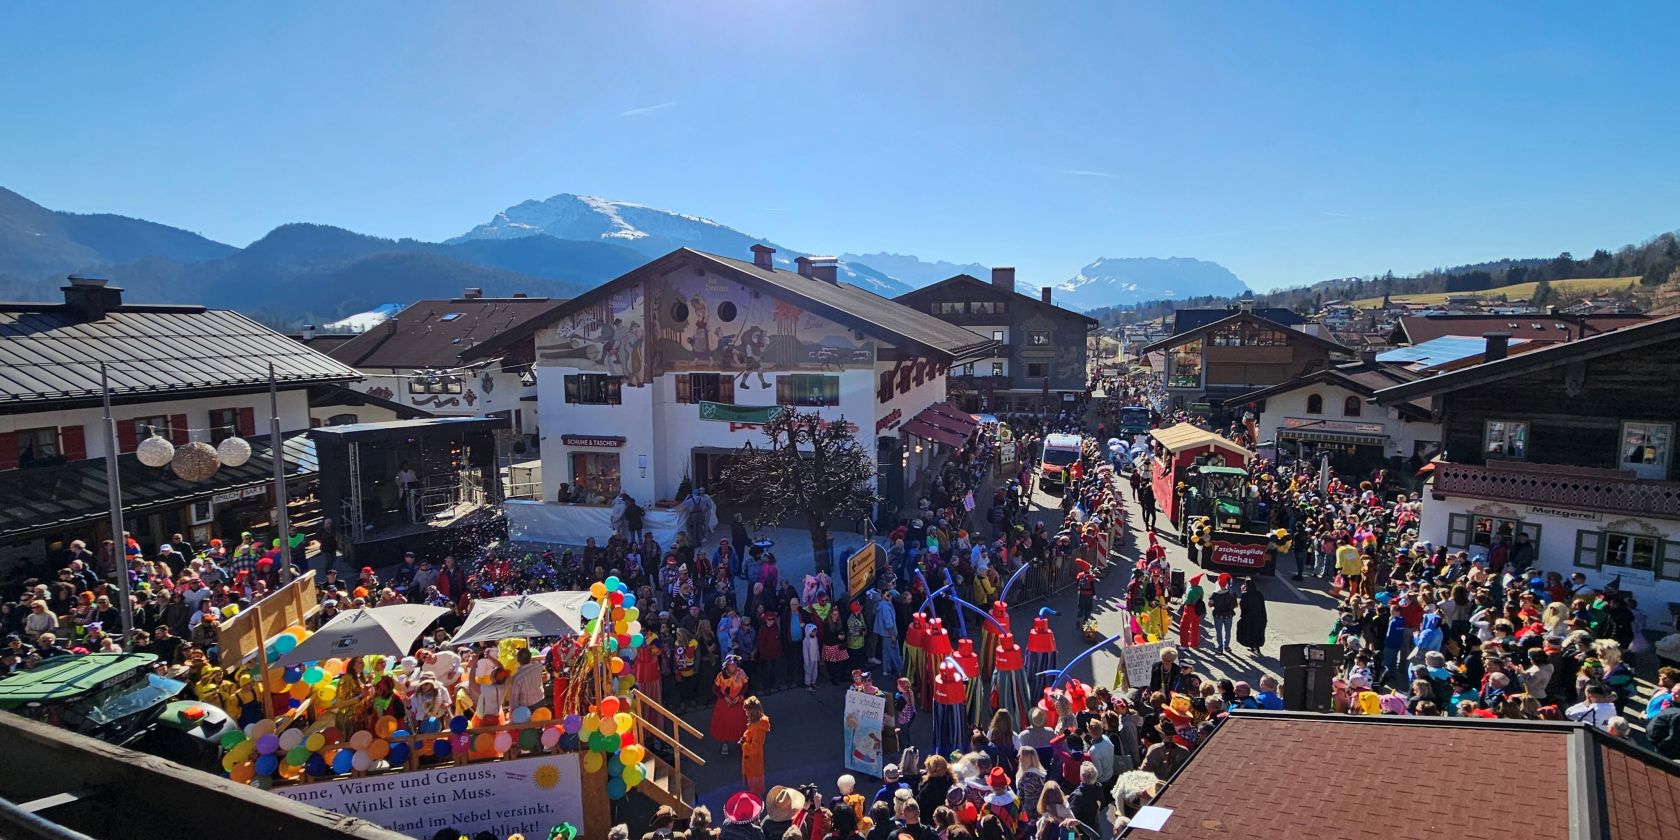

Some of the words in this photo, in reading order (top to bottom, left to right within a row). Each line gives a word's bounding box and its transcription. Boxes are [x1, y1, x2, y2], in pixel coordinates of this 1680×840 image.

[1531, 506, 1596, 520] Metzgerei
[1214, 545, 1264, 555] Faschingsgilde
[1220, 554, 1255, 564] Aschau
[338, 781, 395, 796] Wärme
[400, 772, 430, 788] und
[436, 769, 496, 785] Genuss,
[344, 796, 393, 814] Winkl
[399, 796, 417, 808] ist
[423, 791, 446, 805] ein
[452, 787, 496, 802] Muss.
[428, 817, 447, 829] im
[452, 809, 491, 825] Nebel
[496, 802, 555, 819] versinkt,
